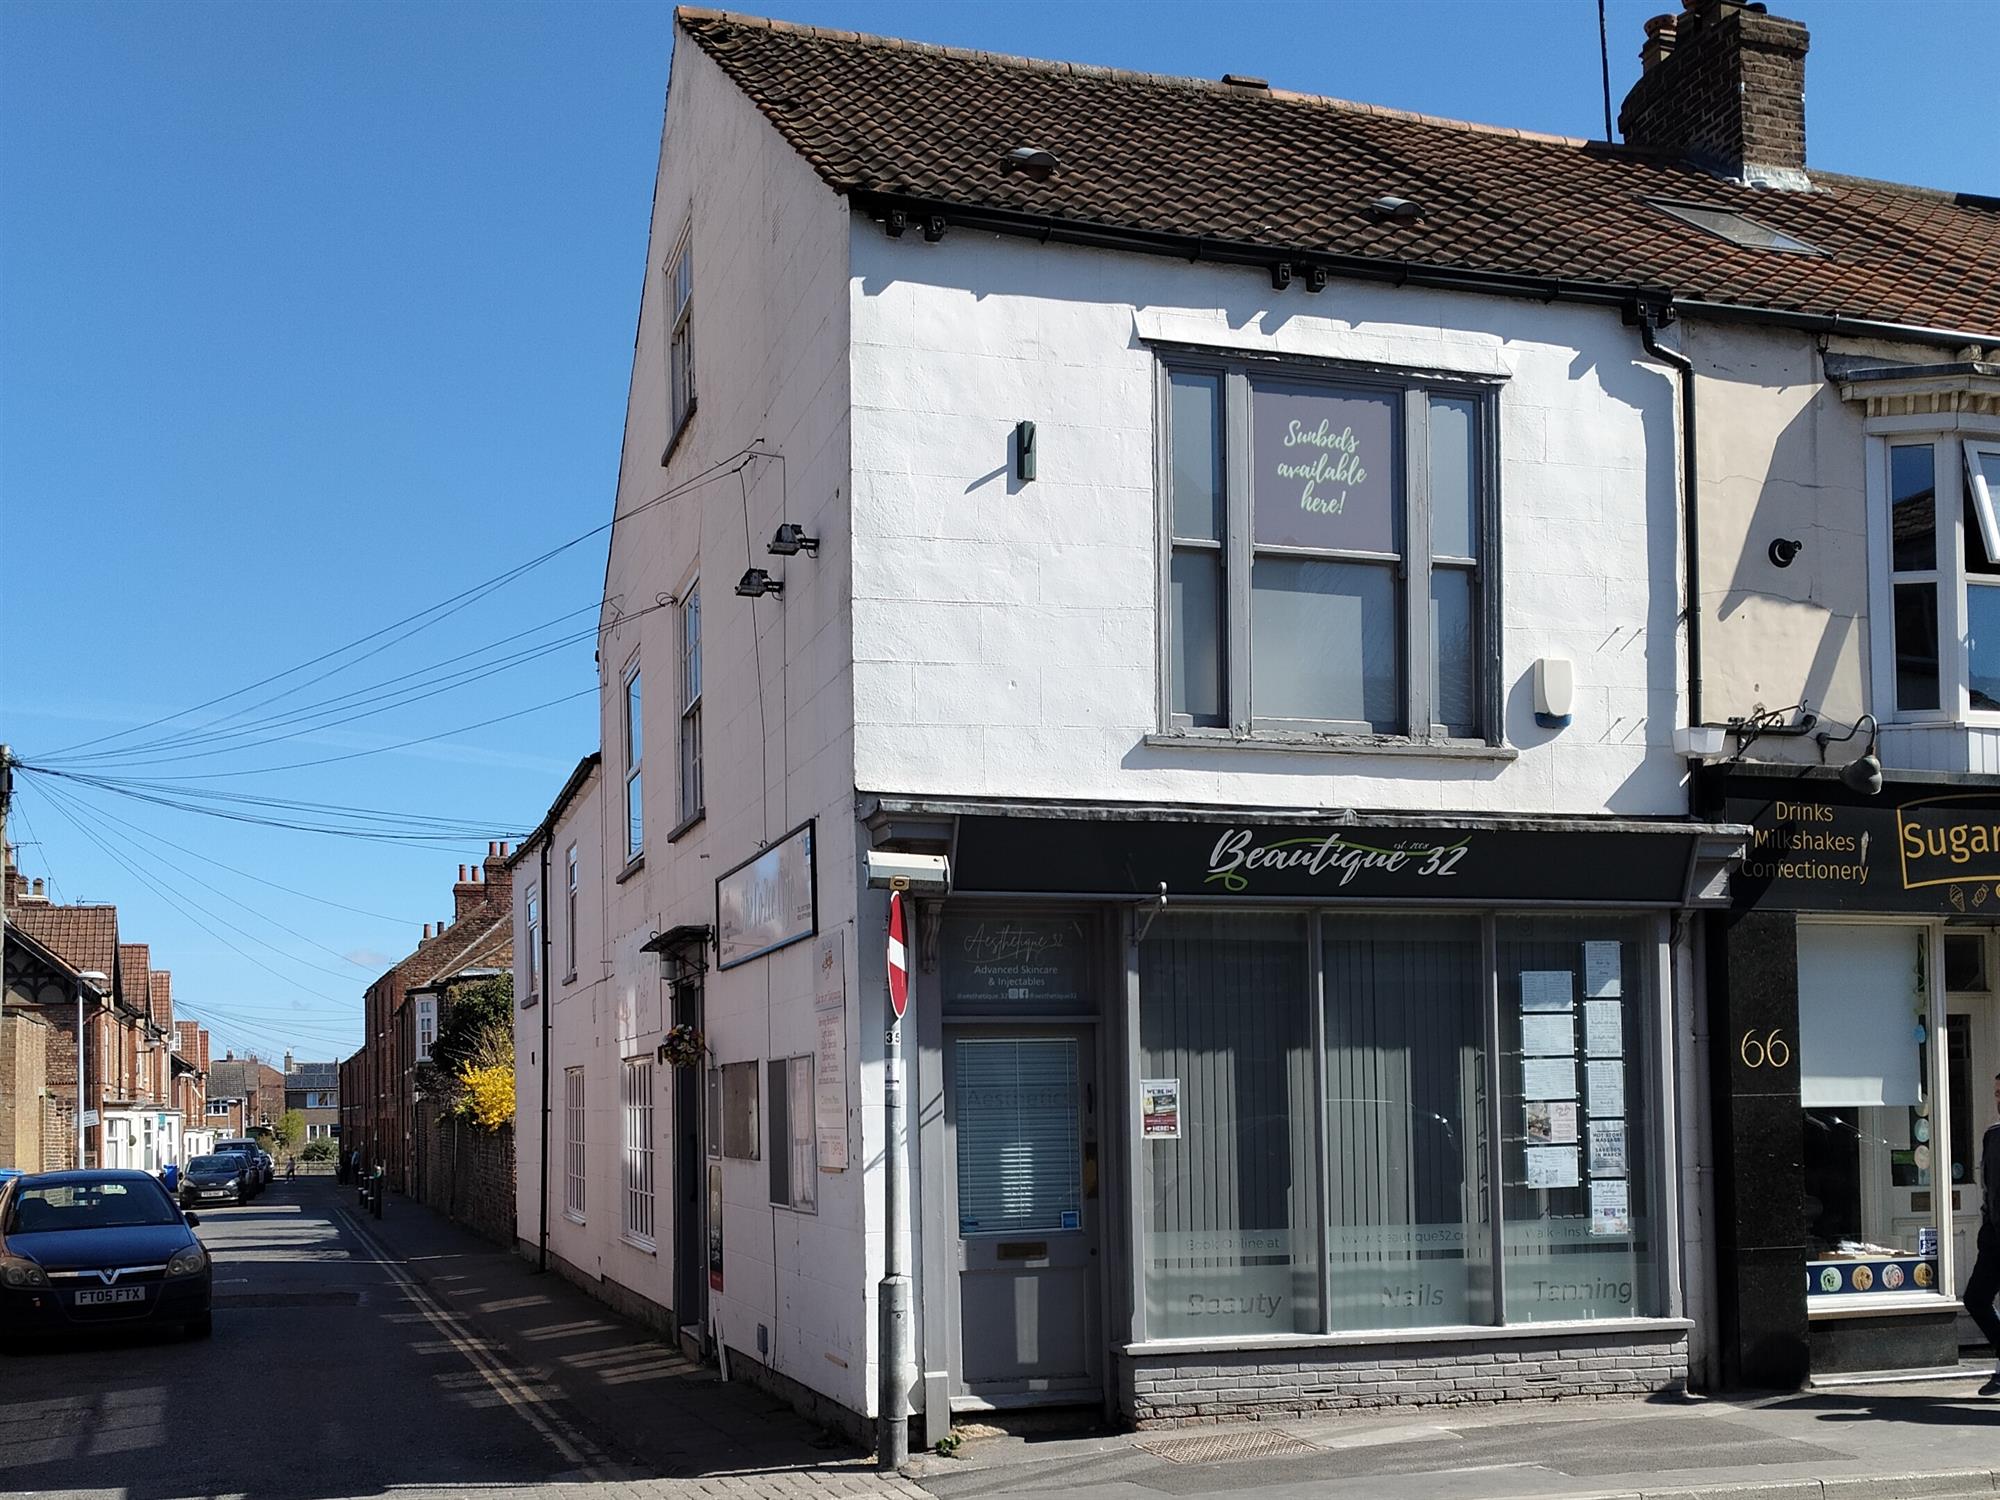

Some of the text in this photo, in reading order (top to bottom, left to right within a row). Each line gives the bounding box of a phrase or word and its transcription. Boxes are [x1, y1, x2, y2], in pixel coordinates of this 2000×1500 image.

[1284, 419, 1359, 453] Sunbeds
[1277, 453, 1367, 485] available
[1301, 480, 1346, 514] here!
[1776, 801, 1833, 822] Drinks
[1754, 828, 1855, 851] Milkshakes
[1207, 829, 1468, 886] Beautique 32
[1742, 859, 1869, 885] Confectionery
[974, 965, 1058, 975] Advanced Skincare
[988, 977, 1045, 987] & Injectables
[1741, 1029, 1789, 1068] 66
[1267, 1237, 1280, 1248] at
[79, 1287, 140, 1304] FT05 FTX
[1382, 1284, 1444, 1308] Nails
[1532, 1278, 1633, 1304] Tanning
[1187, 1293, 1282, 1319] Beauty
